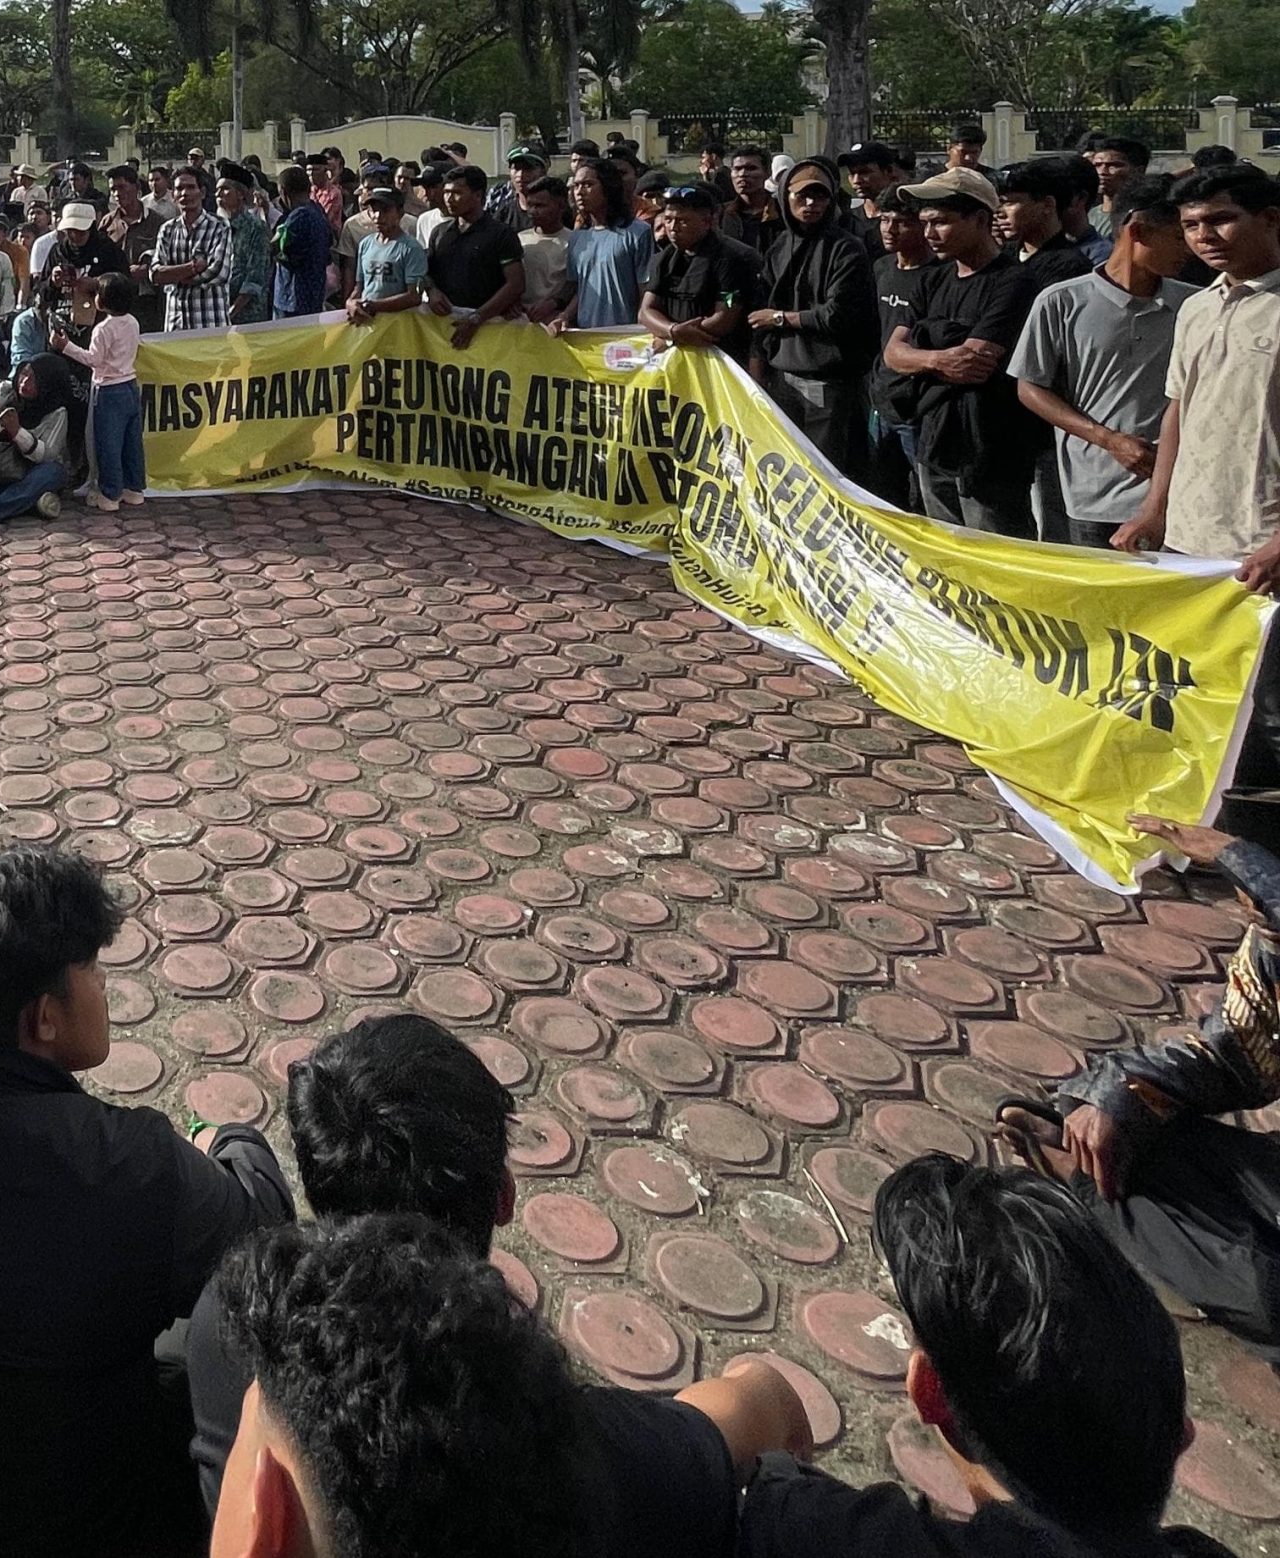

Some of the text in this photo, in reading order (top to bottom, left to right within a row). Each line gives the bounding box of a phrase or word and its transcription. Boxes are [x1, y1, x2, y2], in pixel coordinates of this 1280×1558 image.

[141, 364, 350, 433] MASYARAKAT
[362, 357, 511, 426] BEUTONG
[523, 374, 623, 443] ATEUH
[336, 408, 609, 502] PERTAMBANGAN
